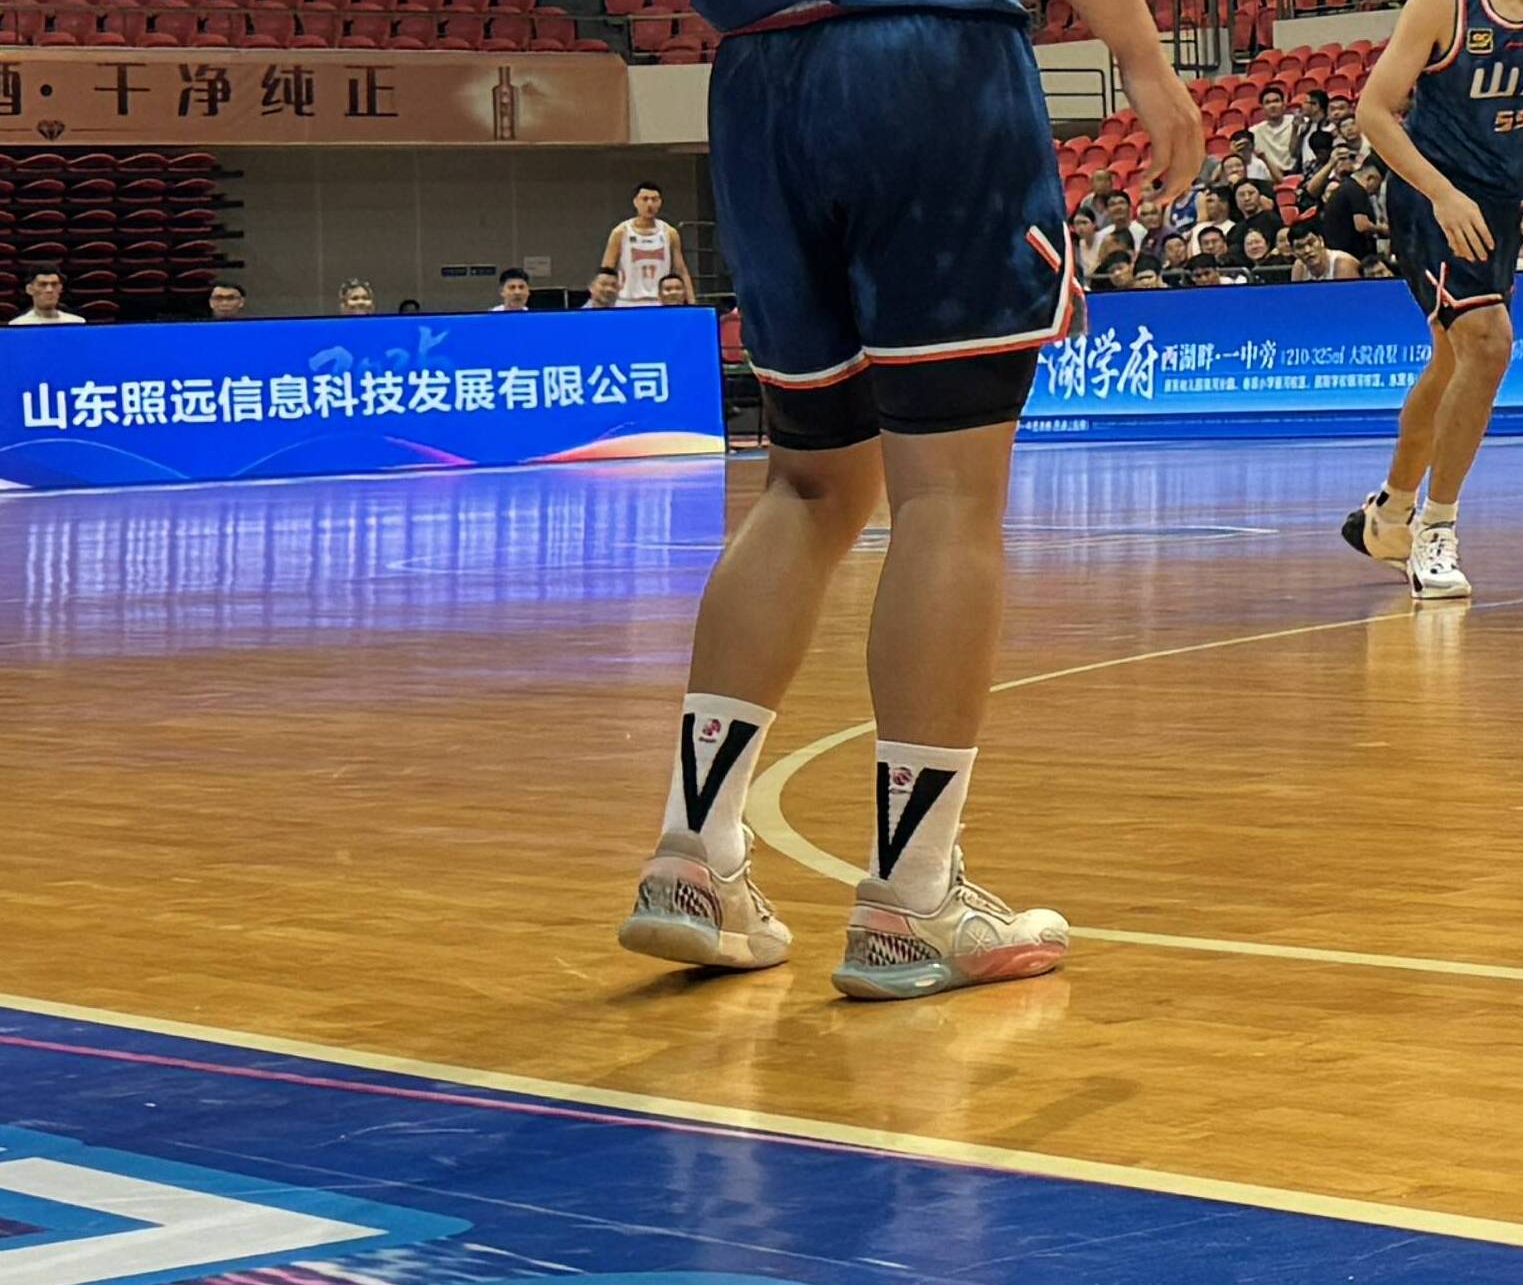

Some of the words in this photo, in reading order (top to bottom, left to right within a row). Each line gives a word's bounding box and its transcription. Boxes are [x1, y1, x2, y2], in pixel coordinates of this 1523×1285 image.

[21, 360, 671, 430] 山东照远信息科技发展有限公司
